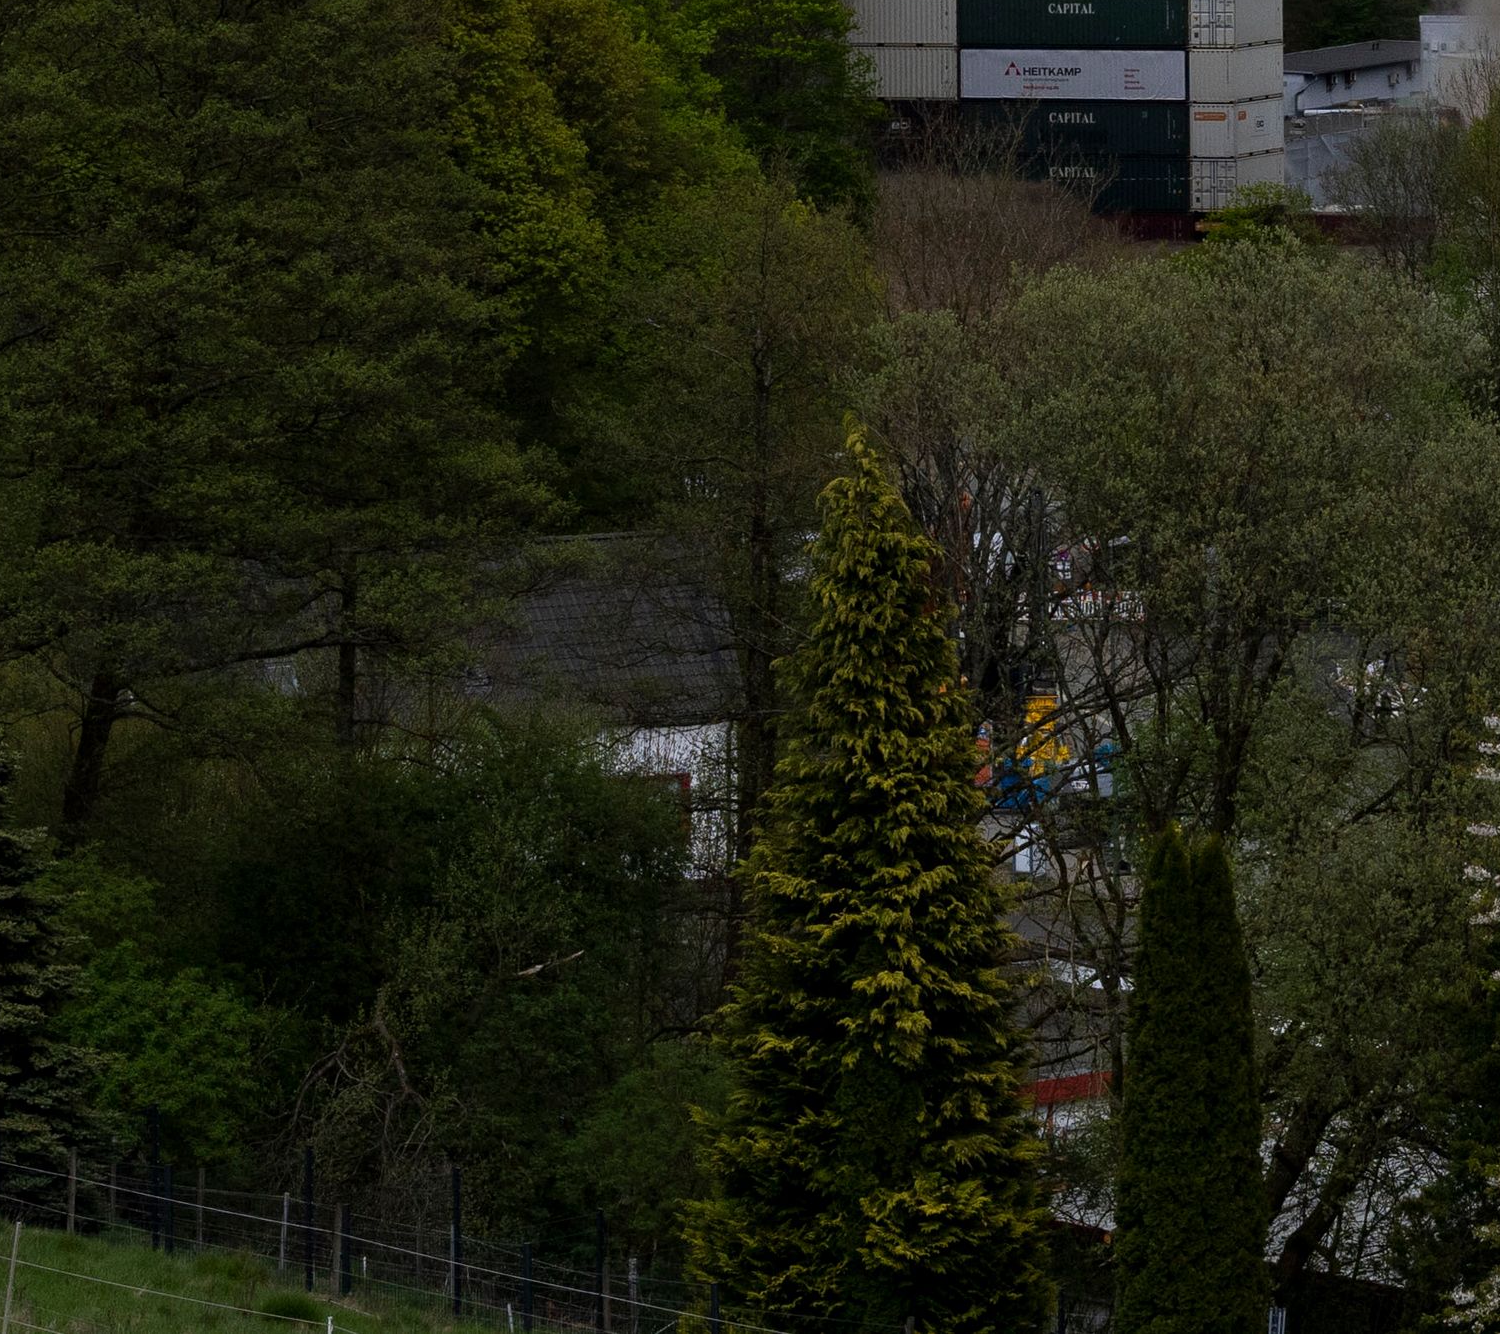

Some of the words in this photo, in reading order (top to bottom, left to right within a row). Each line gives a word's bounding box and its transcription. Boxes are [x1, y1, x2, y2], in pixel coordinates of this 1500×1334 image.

[1048, 3, 1095, 14] CAPITAL
[1022, 67, 1082, 77] HEITKAMP
[1049, 112, 1096, 124] CAPITAL
